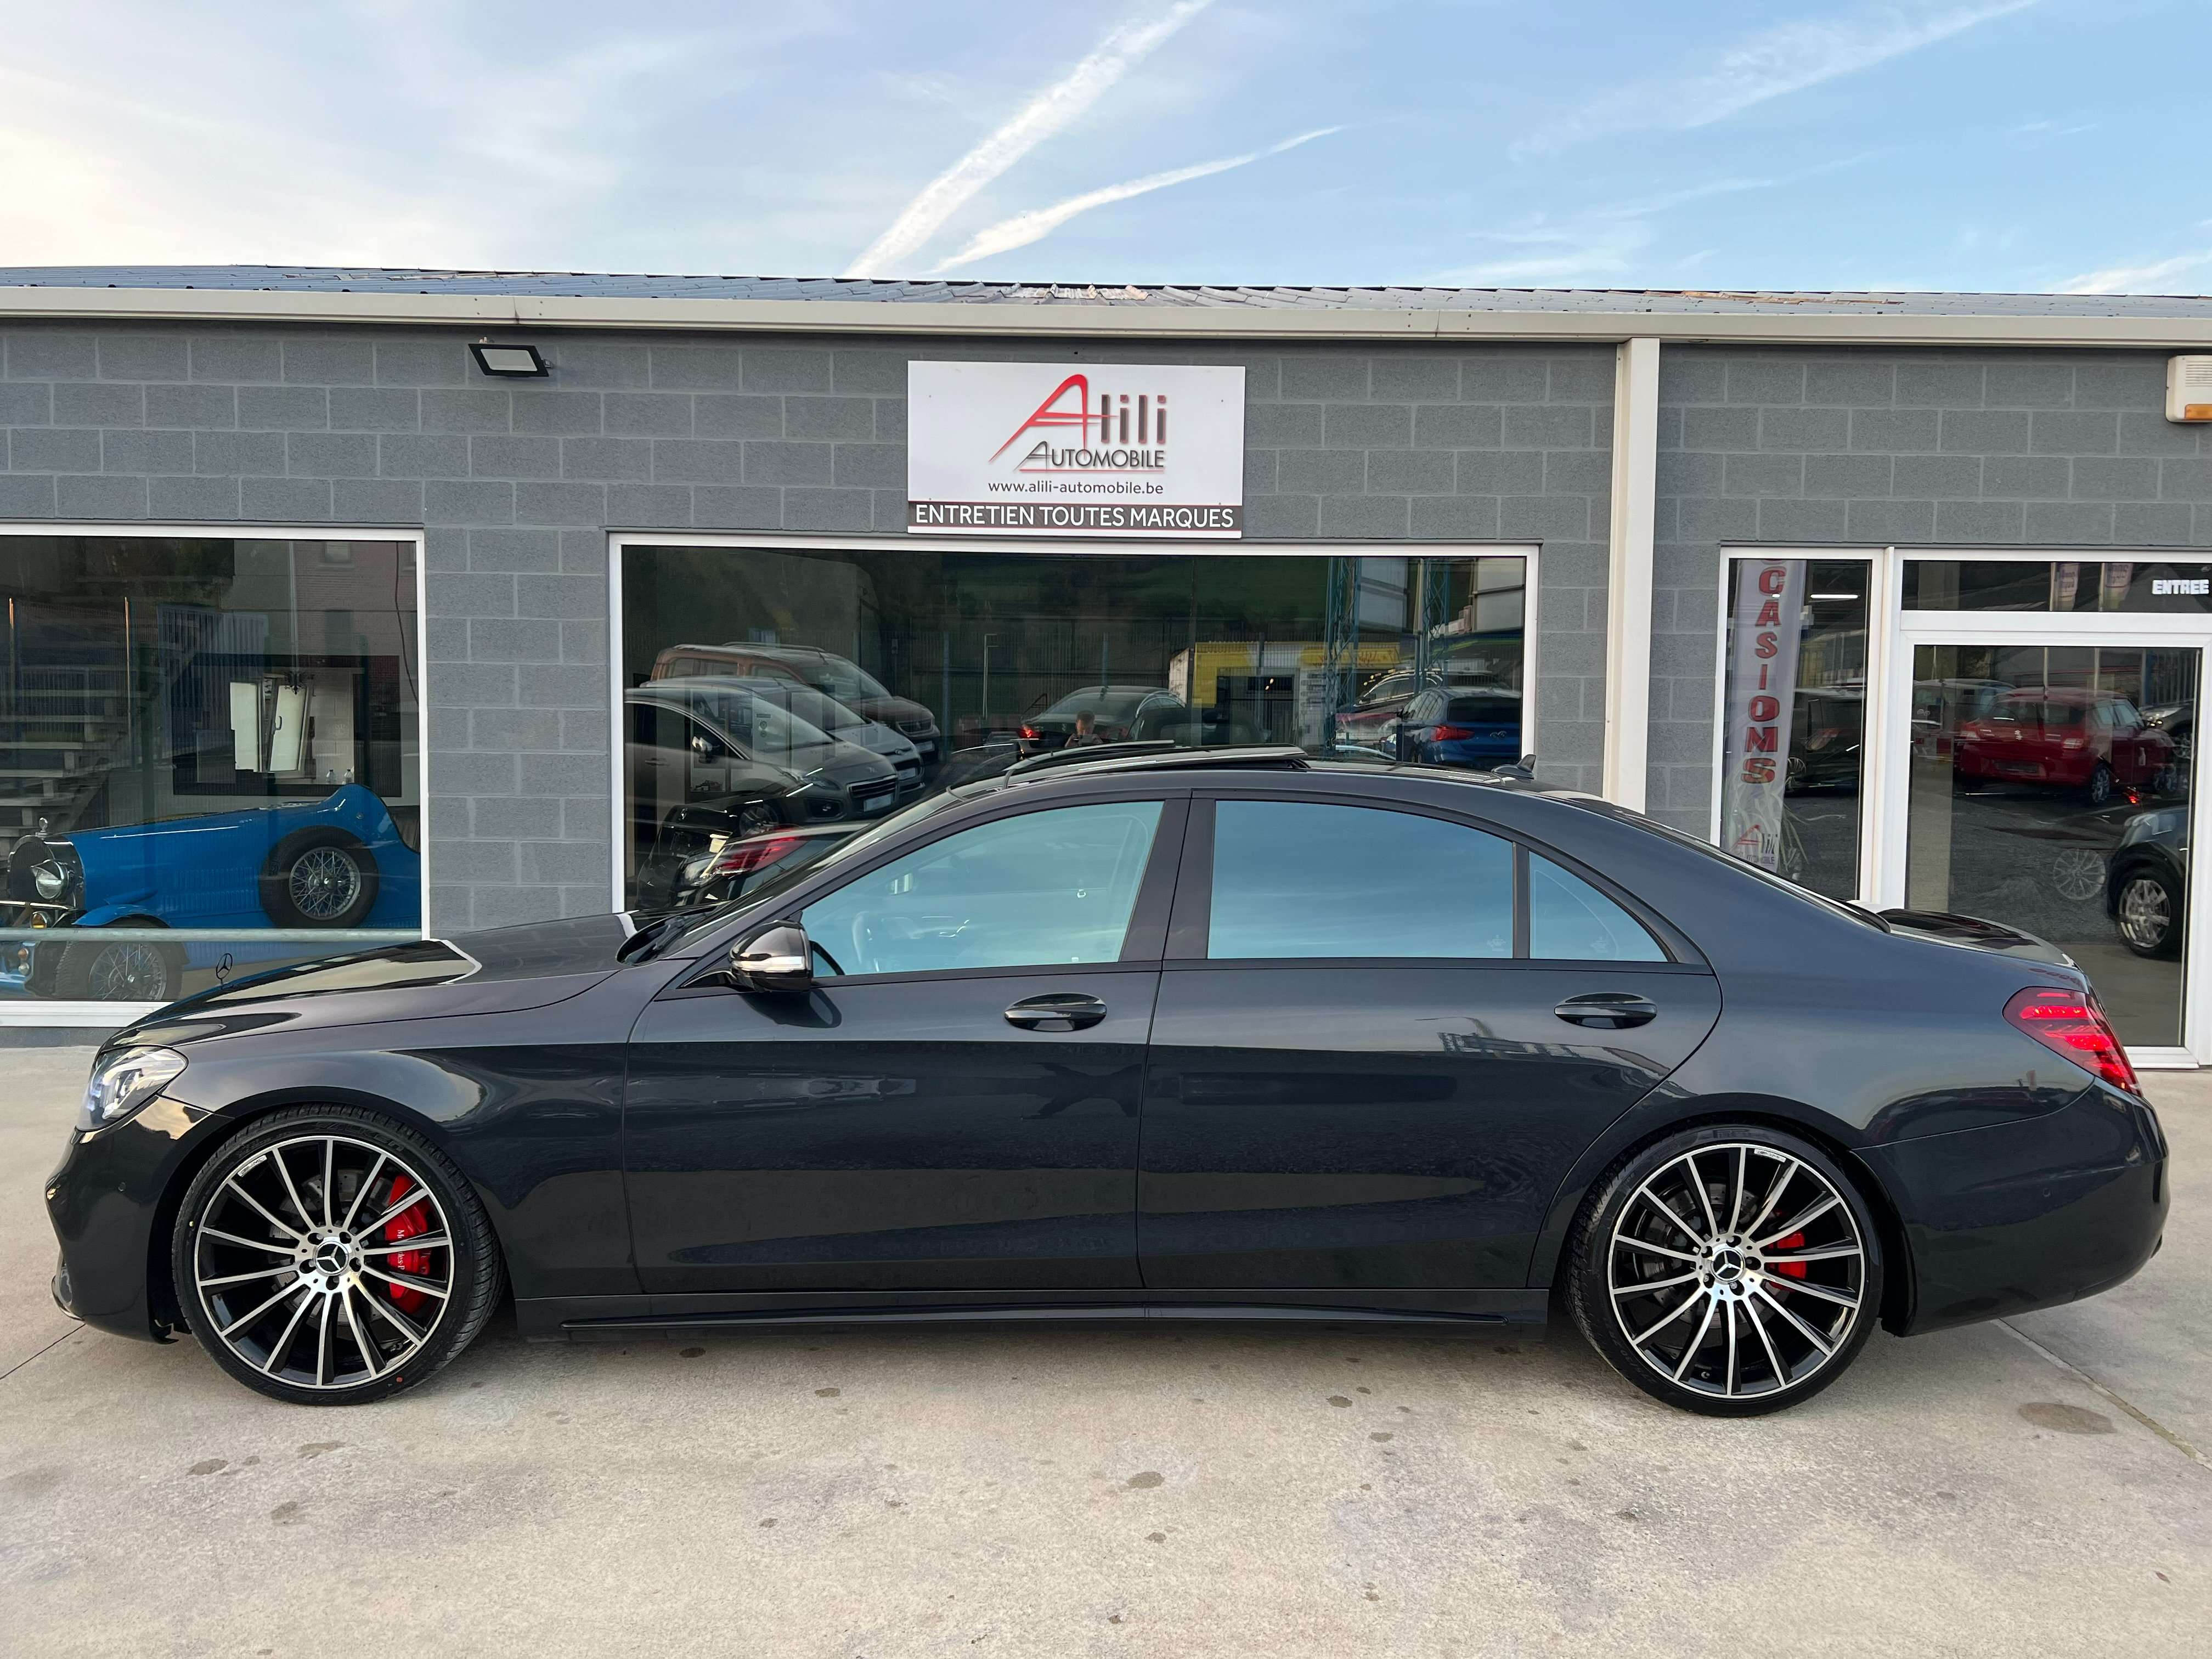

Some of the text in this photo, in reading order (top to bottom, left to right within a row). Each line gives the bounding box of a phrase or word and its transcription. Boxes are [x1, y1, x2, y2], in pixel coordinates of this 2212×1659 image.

[988, 374, 1166, 462] Alili
[1012, 441, 1165, 473] AUTOMOBILE
[988, 481, 1164, 495] www.alili-automobile.be
[915, 504, 1234, 530] ENTRETIEN TOUTES MARQUES
[2152, 579, 2209, 595] ENTREE
[1741, 560, 1787, 784] CASIONS
